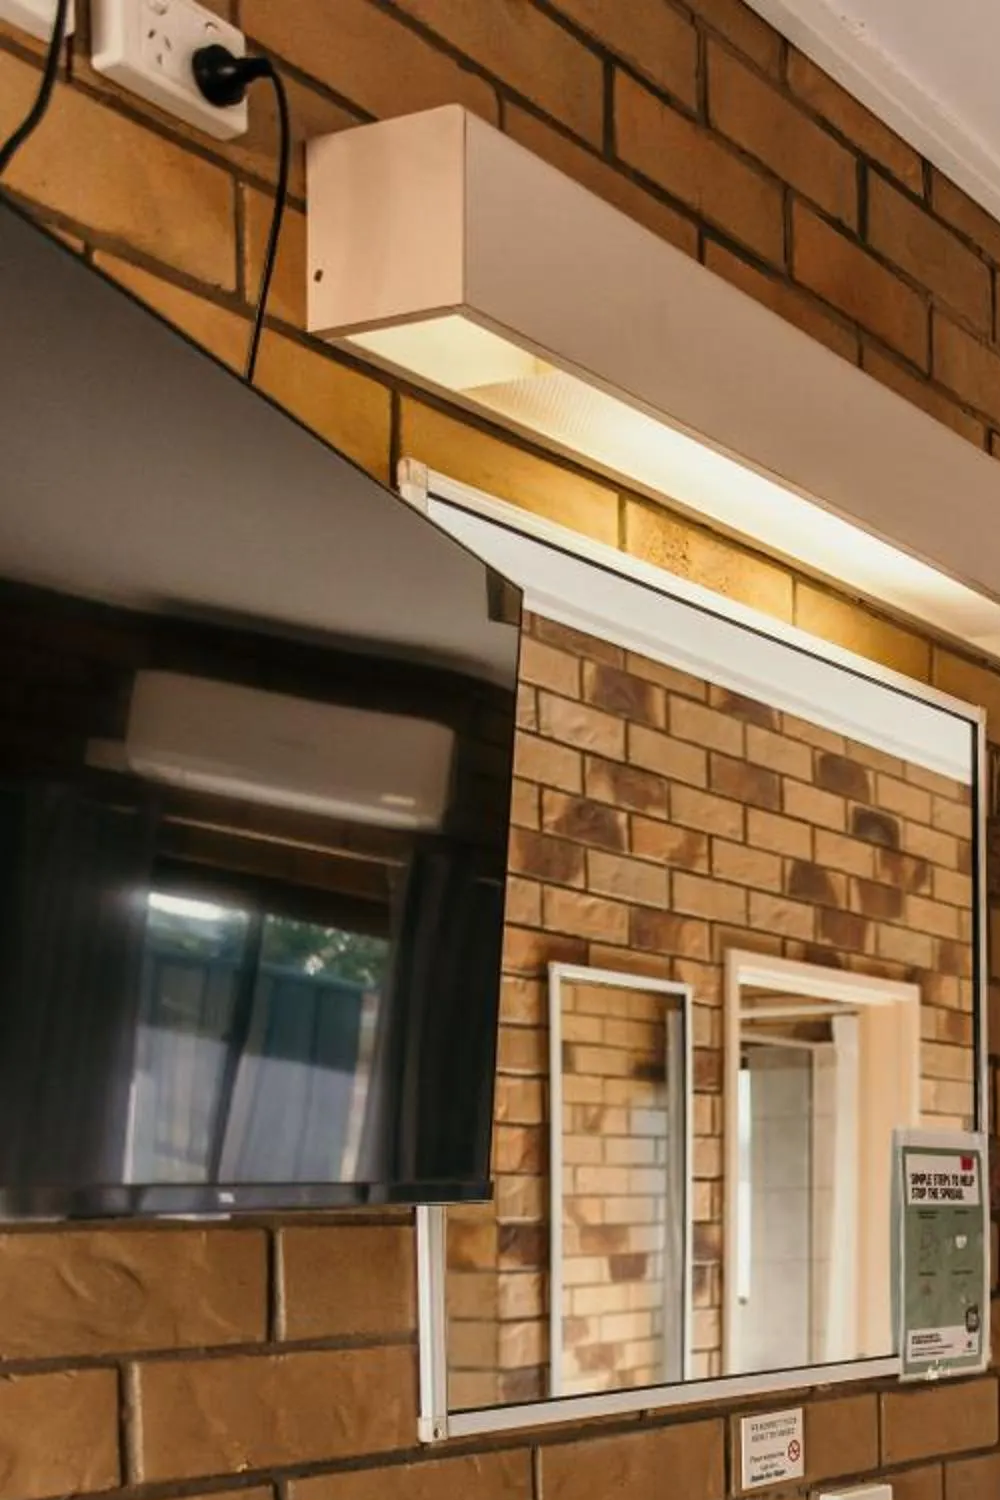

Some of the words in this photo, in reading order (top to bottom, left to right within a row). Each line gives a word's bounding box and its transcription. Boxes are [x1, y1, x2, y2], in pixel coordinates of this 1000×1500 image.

[911, 1173, 932, 1186] SIMPLE
[933, 1173, 950, 1187] STEPS
[911, 1187, 926, 1200] STOP
[928, 1187, 939, 1200] THE
